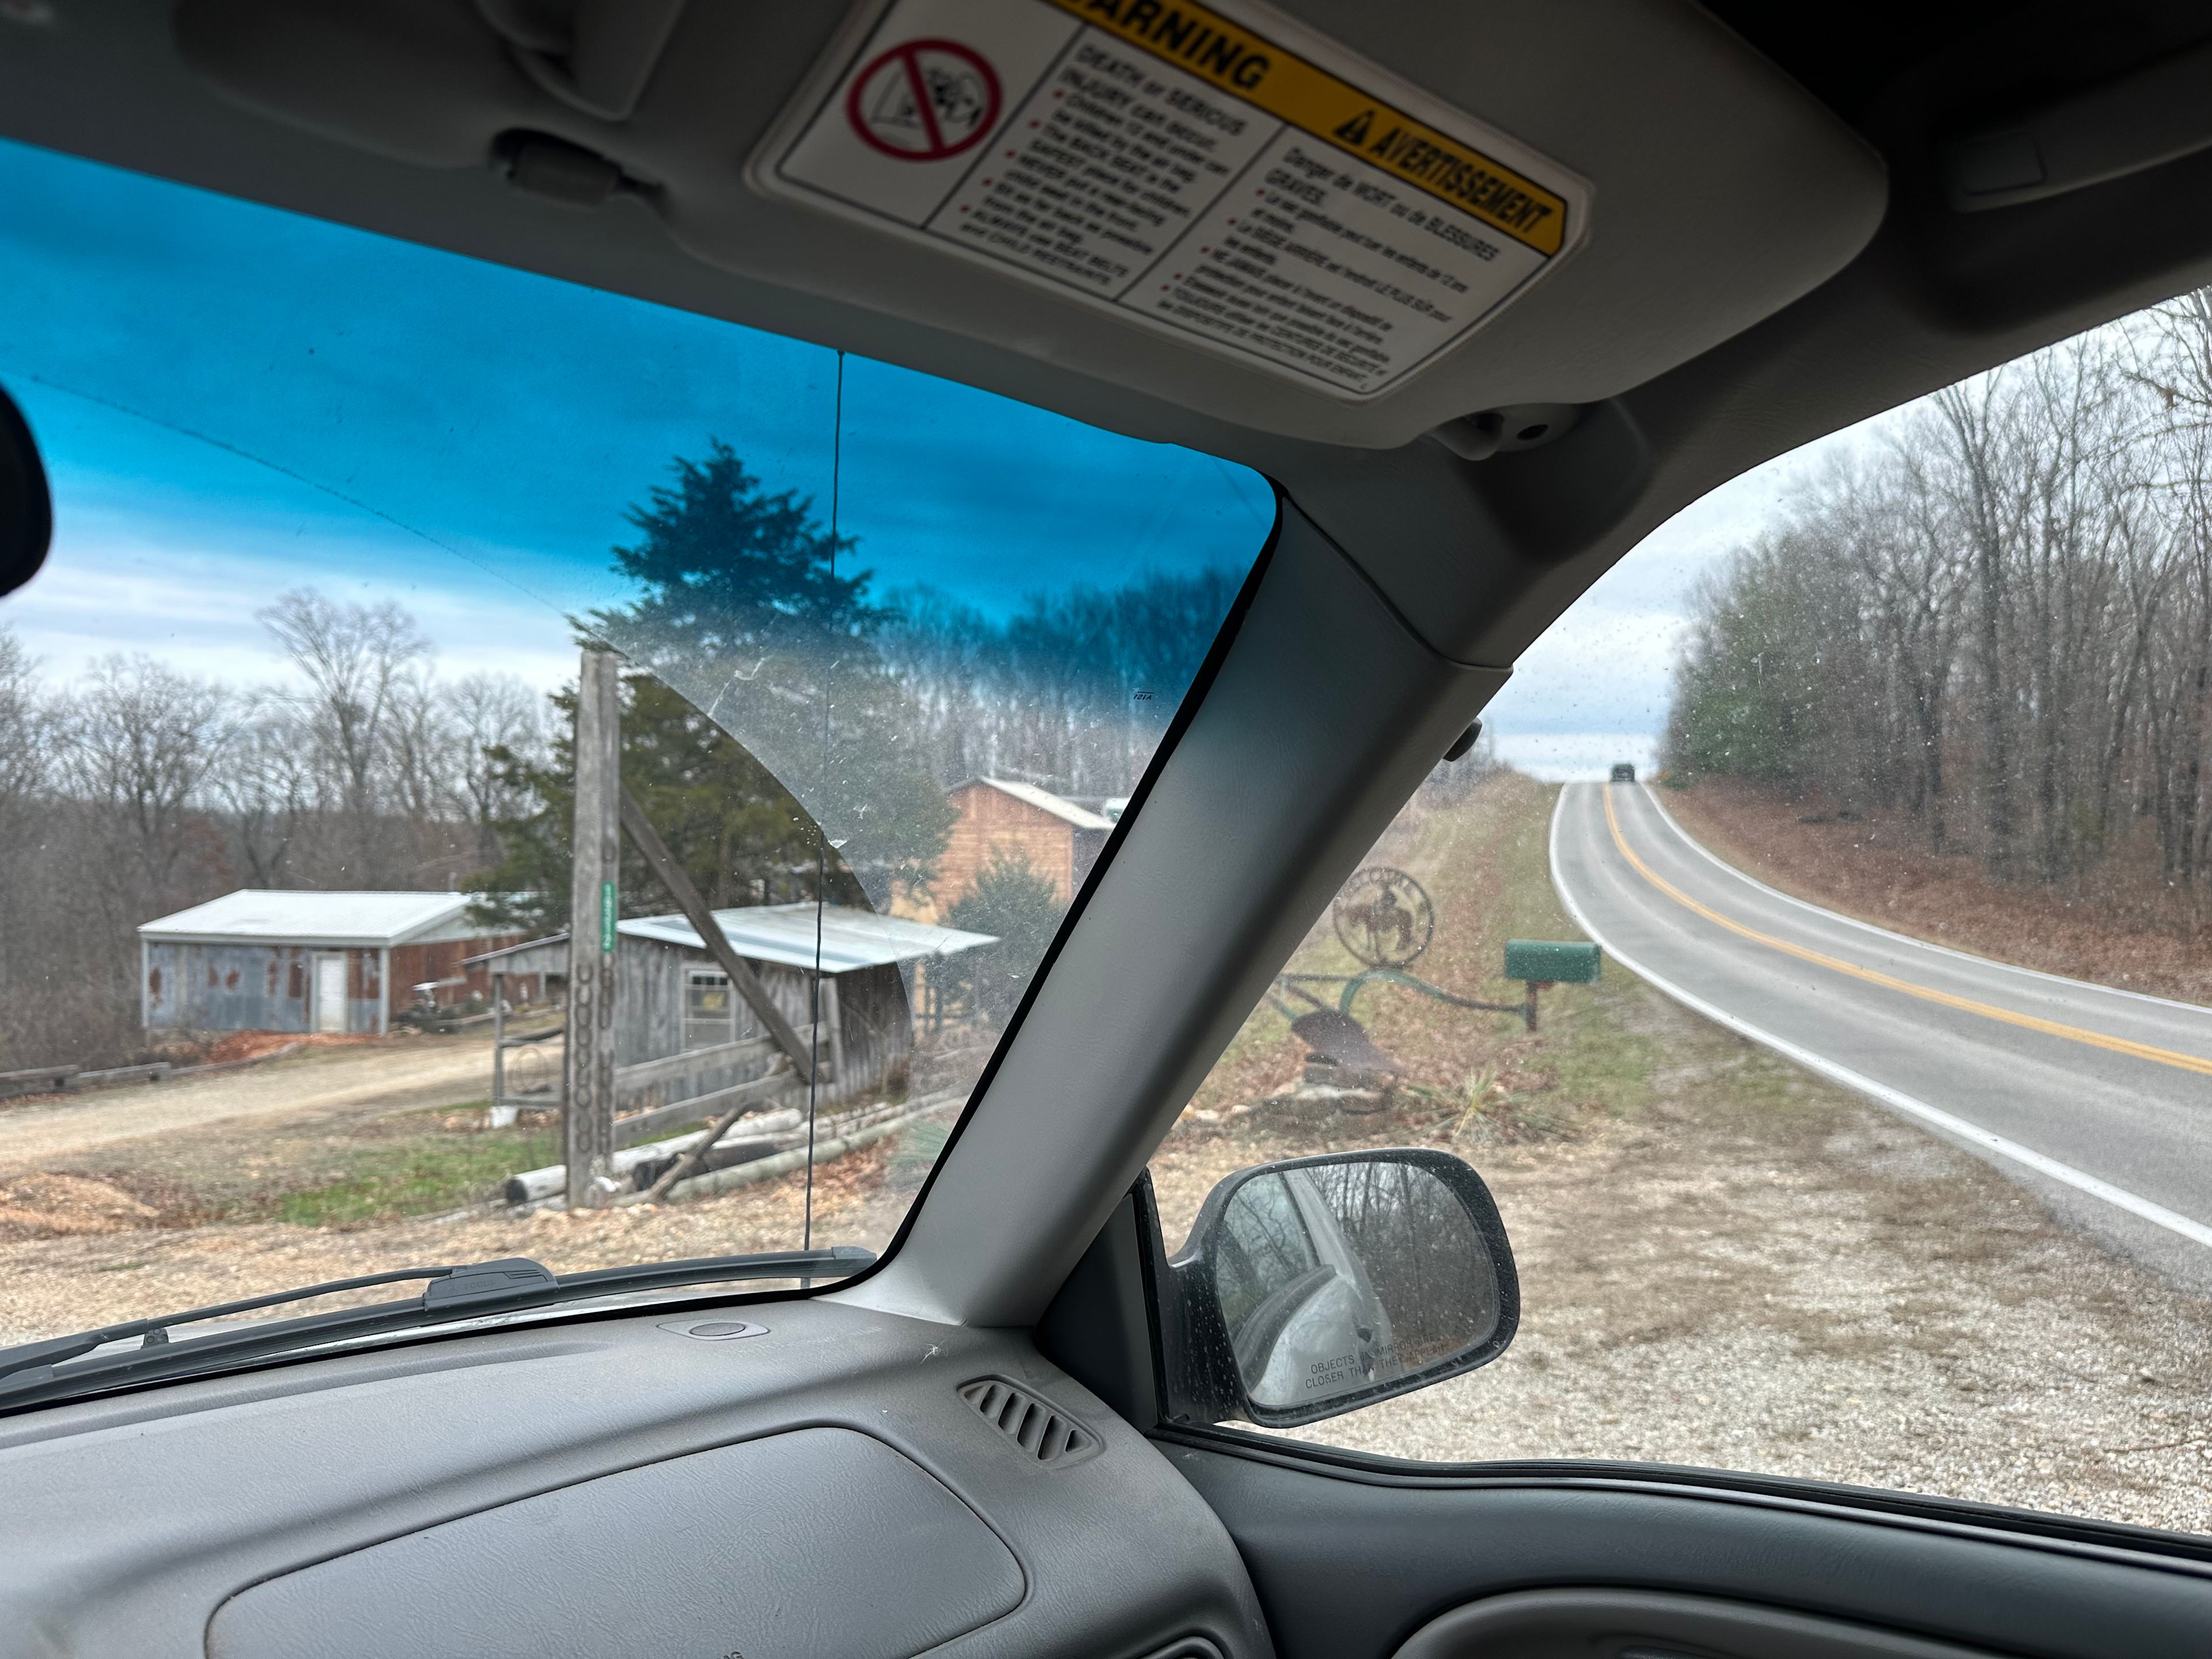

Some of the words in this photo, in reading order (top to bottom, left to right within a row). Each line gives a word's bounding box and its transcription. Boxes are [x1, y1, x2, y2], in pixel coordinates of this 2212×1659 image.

[1078, 0, 1270, 90] ARNING
[1369, 125, 1552, 233] AVERTISSEMENT
[463, 1279, 496, 1290] FOCUS
[1305, 1370, 1344, 1388] CLOSER
[1381, 1354, 1403, 1369] THEY
[1310, 1355, 1354, 1374] OBJECTS
[1360, 1350, 1371, 1361] IN
[1376, 1339, 1412, 1356] MIRROR
